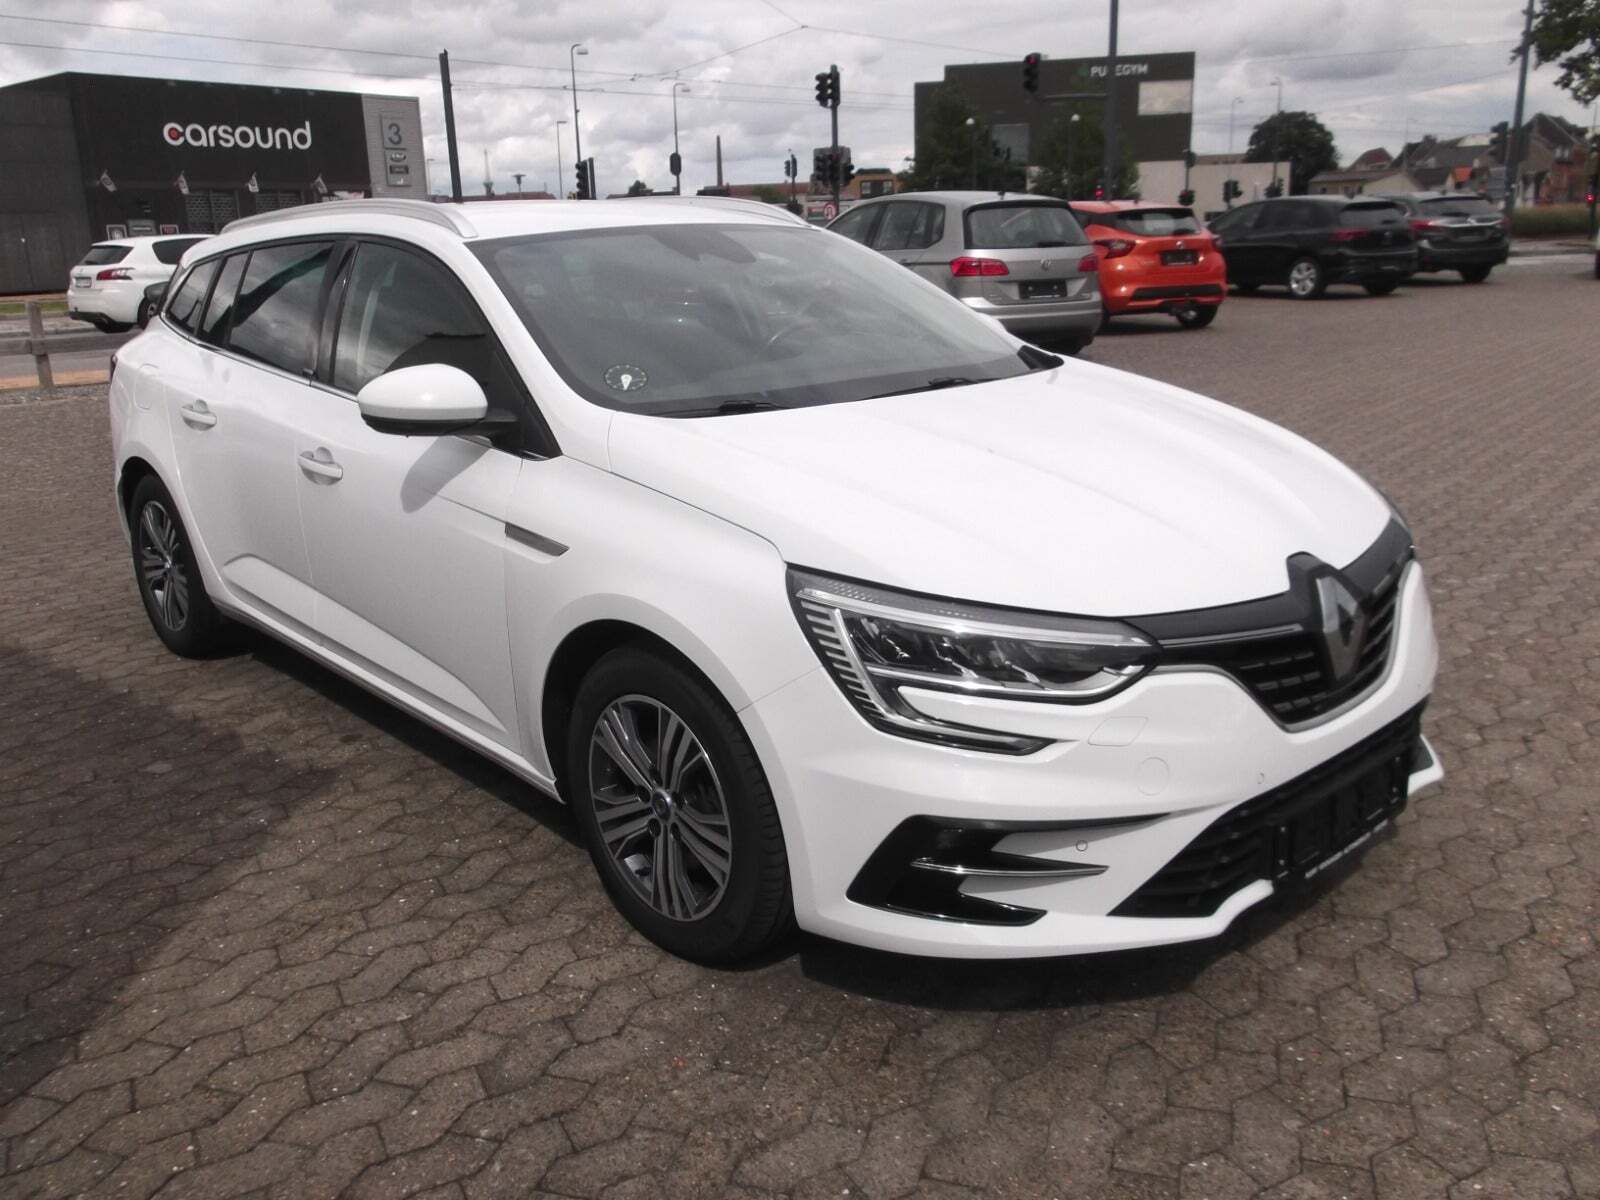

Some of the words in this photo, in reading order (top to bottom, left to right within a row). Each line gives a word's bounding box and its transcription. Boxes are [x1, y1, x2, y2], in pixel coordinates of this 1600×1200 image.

[1090, 63, 1149, 77] PUEGYM
[163, 120, 312, 150] carsound
[388, 123, 402, 145] 3
